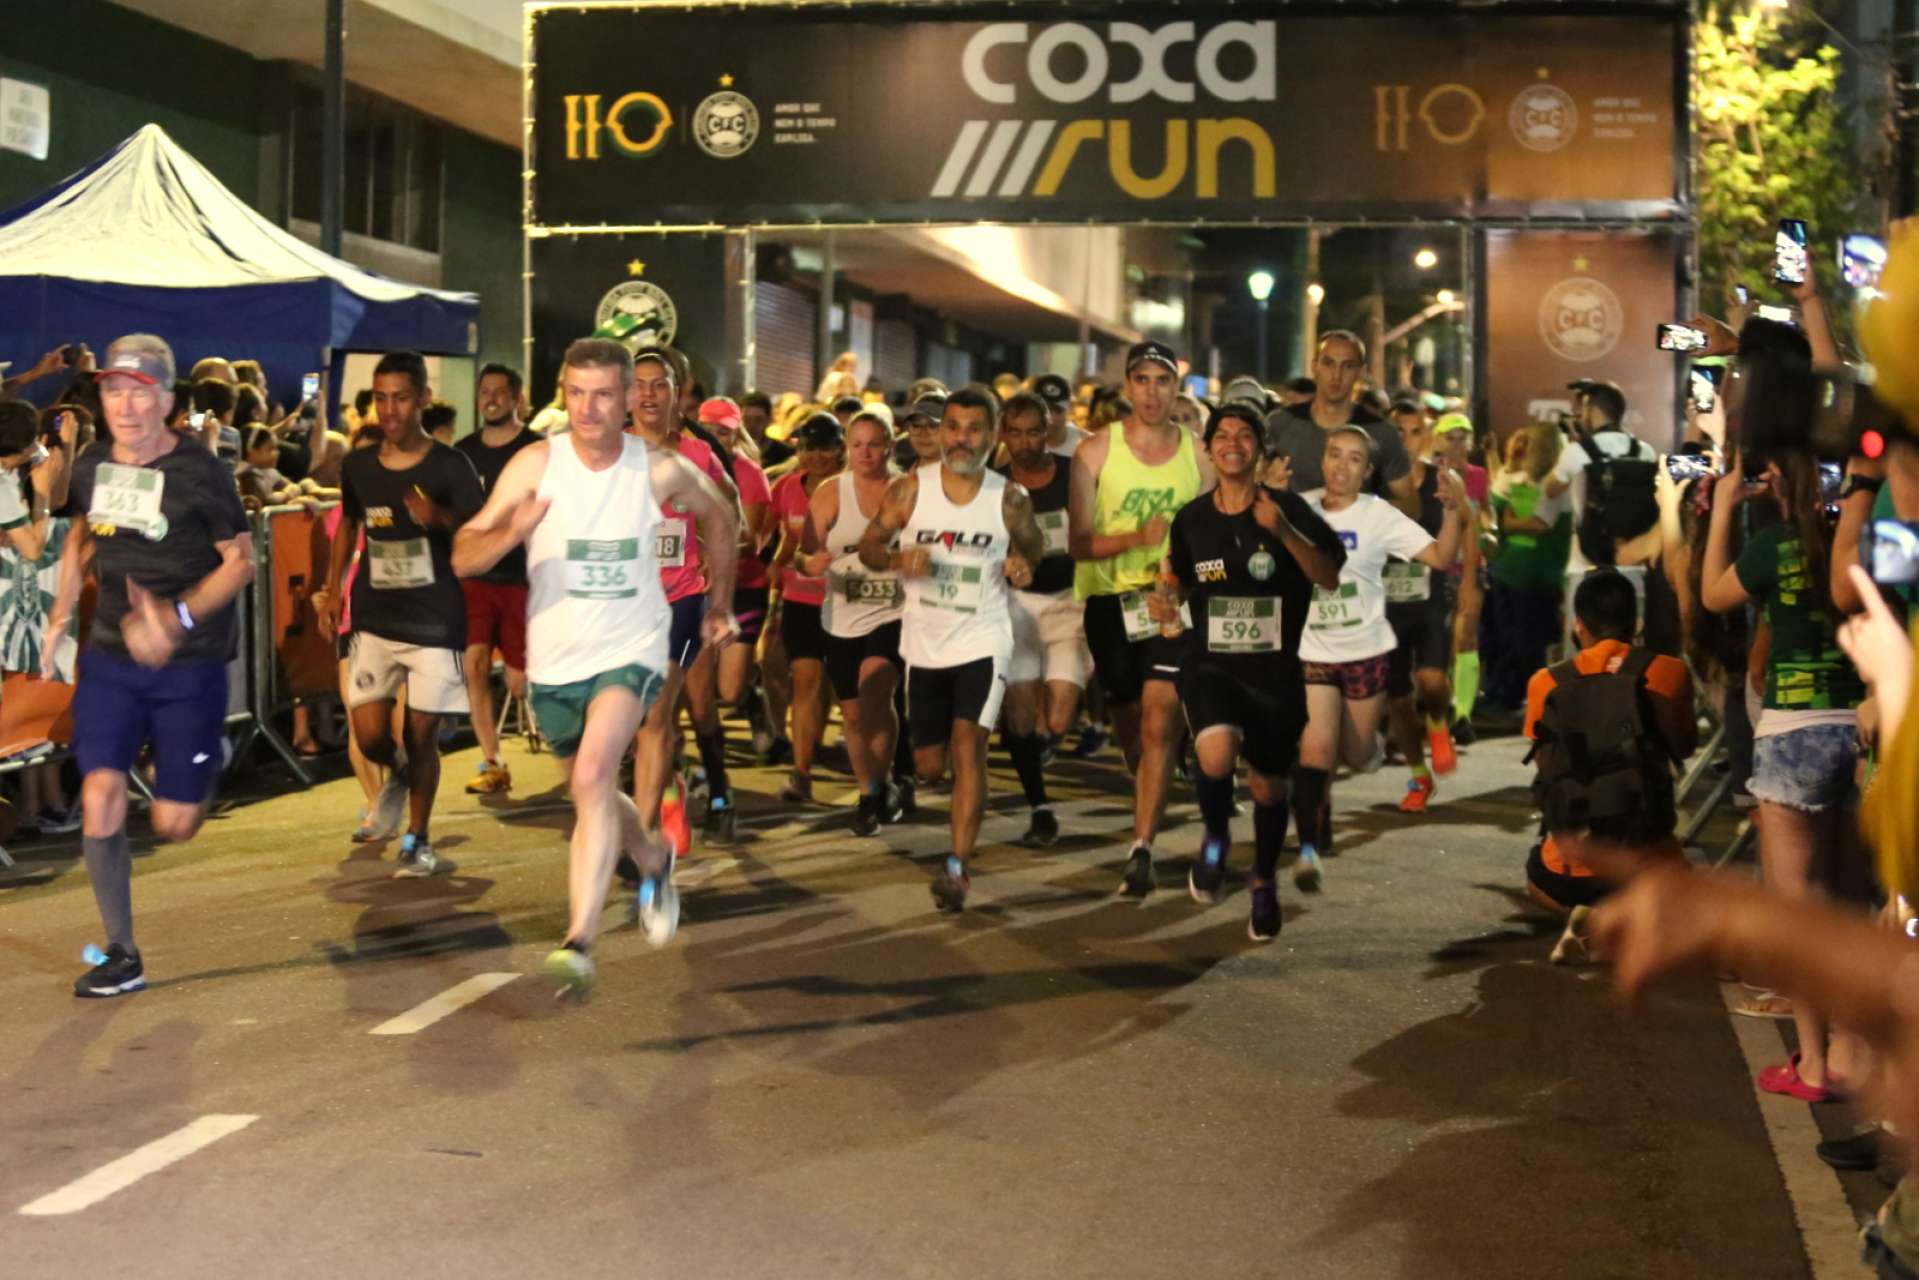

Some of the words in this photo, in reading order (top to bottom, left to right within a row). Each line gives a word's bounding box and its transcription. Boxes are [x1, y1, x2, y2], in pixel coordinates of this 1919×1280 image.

[581, 565, 628, 587] 336
[1318, 602, 1348, 619] 591
[1222, 621, 1261, 640] 596
